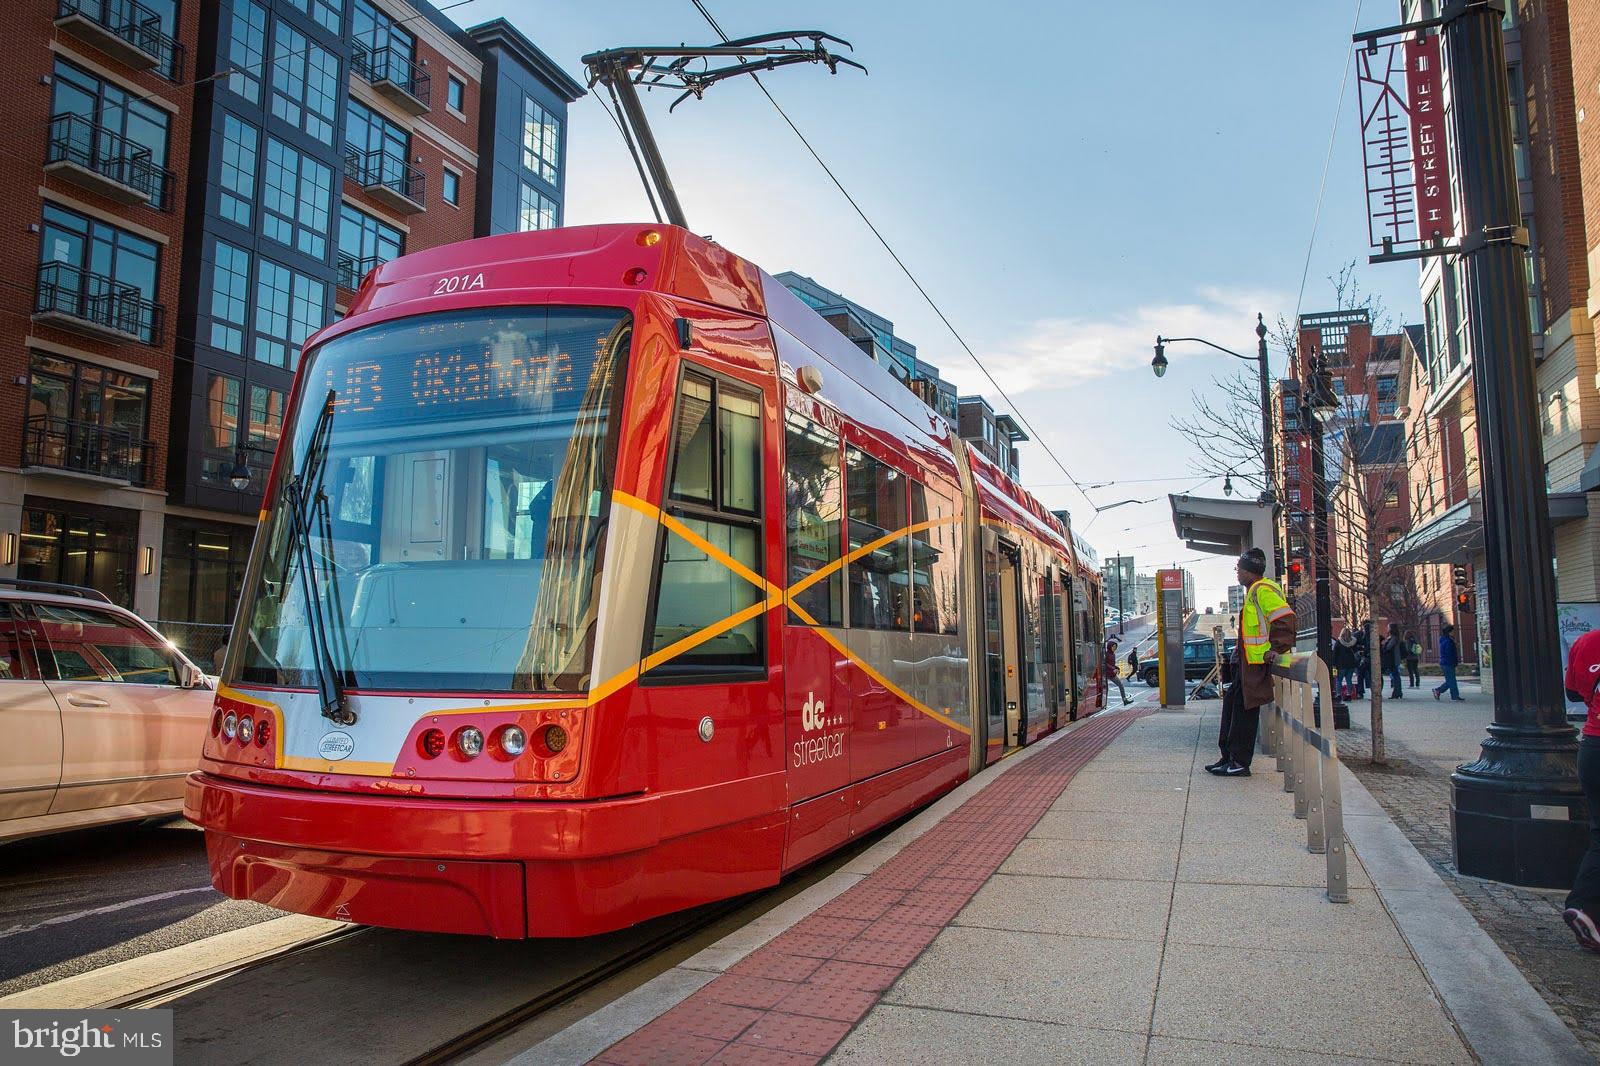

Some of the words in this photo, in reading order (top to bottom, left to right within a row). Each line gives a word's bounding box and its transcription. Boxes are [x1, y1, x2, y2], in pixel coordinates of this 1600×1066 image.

[1419, 123, 1440, 198] STREET
[433, 272, 485, 295] 201A
[802, 692, 825, 732] dc
[793, 730, 845, 768] streetcar
